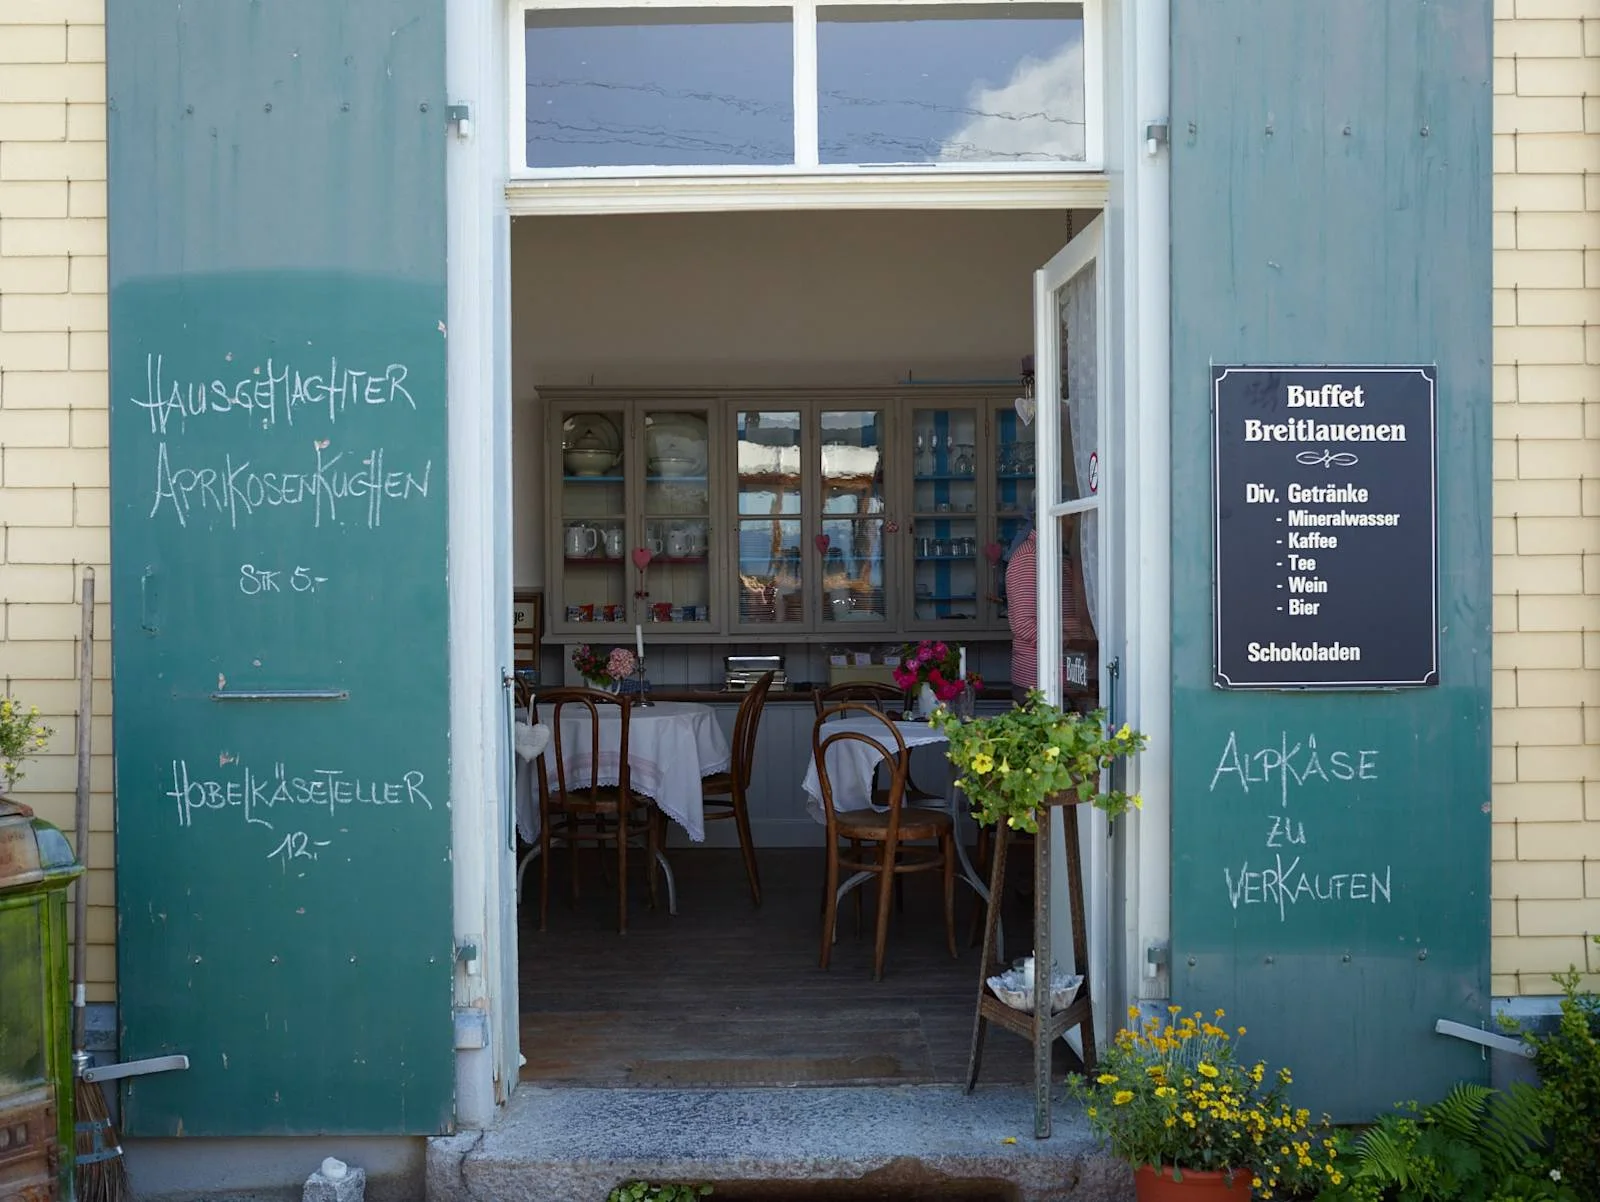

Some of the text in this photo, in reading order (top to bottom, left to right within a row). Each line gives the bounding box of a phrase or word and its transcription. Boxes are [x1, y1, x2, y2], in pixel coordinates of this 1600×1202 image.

[131, 353, 416, 434] HAUSGEMACHTER
[1287, 384, 1366, 408] Buffet
[1244, 417, 1407, 442] Breitlauenen
[150, 442, 431, 529] APRIKOSENKUCHEN
[1246, 483, 1369, 503] Div. Getränke
[1288, 510, 1400, 527] Mineralwasser
[1288, 532, 1338, 549] Kaffee
[1288, 554, 1317, 571] Tee
[1288, 576, 1328, 593] Wein
[1289, 598, 1320, 616] Bier
[1248, 642, 1361, 662] Schokoladen
[1209, 730, 1380, 808] ALPKÄSE
[166, 760, 433, 830] HOBELKÄSETELLER
[1266, 815, 1307, 847] ZU
[1223, 853, 1392, 922] VERKAUFEN
